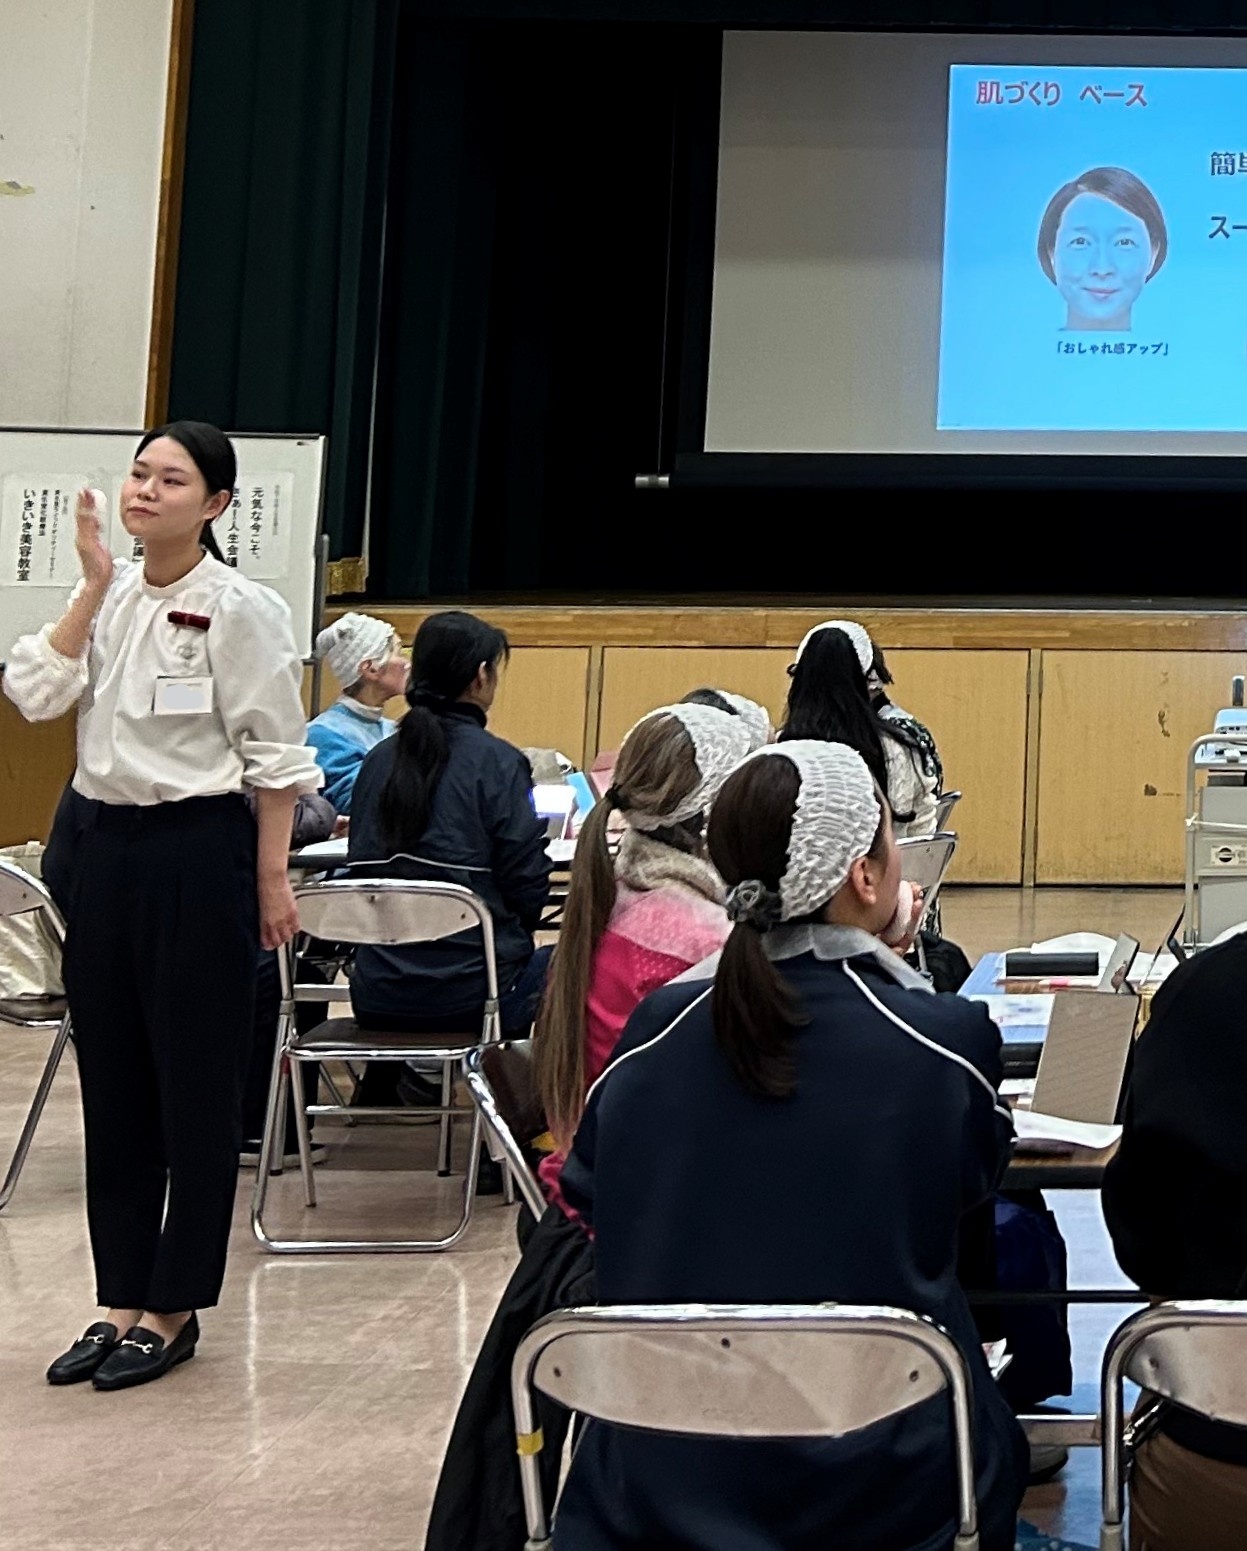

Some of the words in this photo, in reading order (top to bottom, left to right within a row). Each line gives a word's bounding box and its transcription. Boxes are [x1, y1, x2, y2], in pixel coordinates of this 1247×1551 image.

[976, 80, 1061, 106] 肌づくり
[1079, 84, 1148, 107] ベース
[1057, 340, 1169, 356] 「おしゃれ感アップ」
[16, 489, 36, 581] いきいき美容教室
